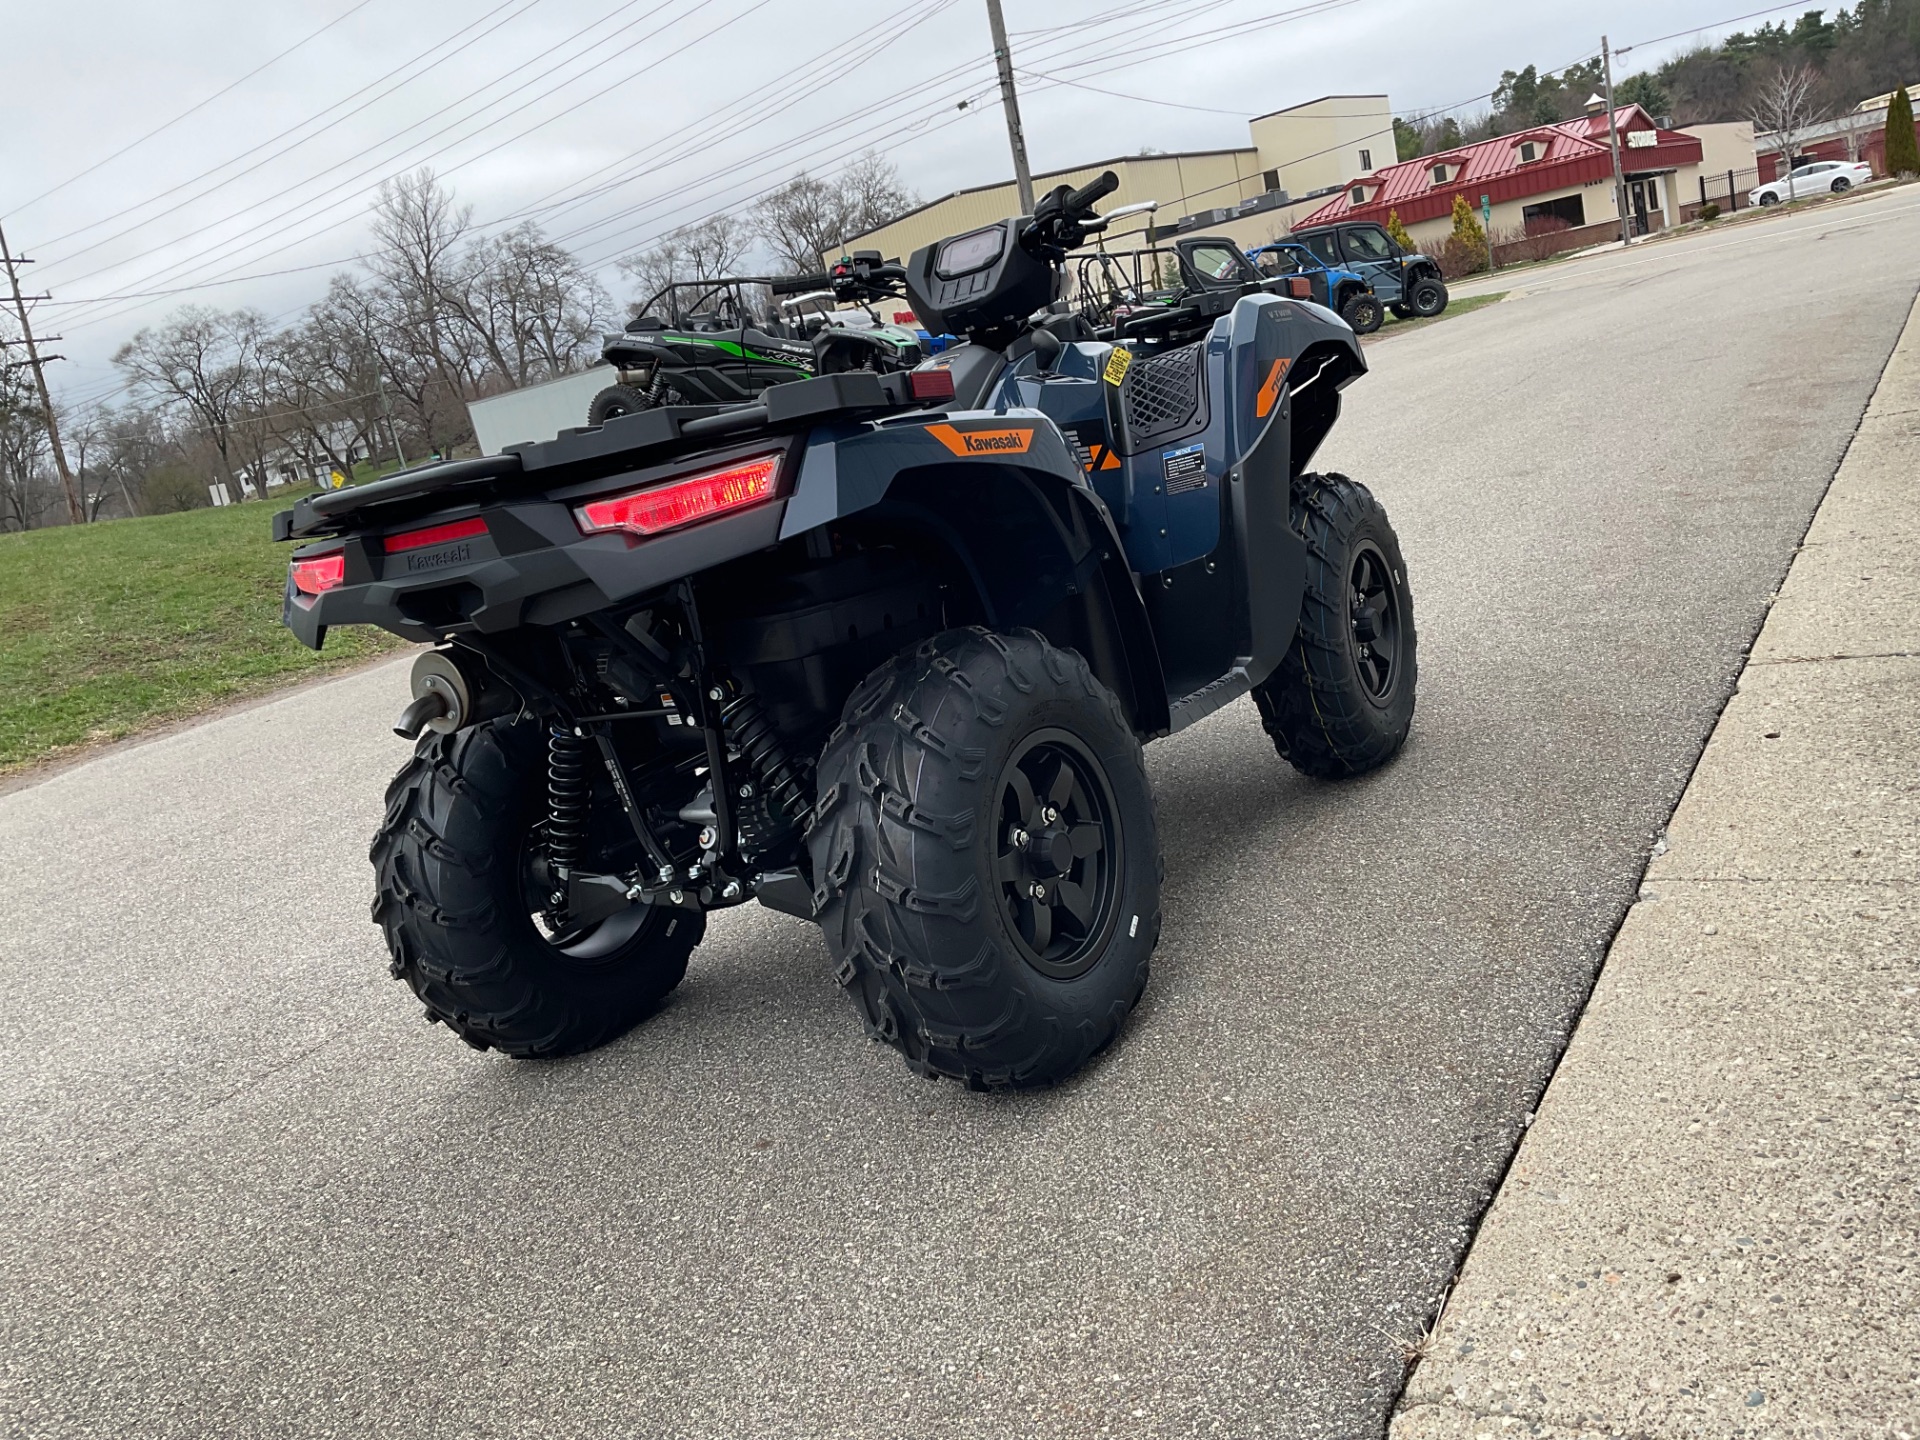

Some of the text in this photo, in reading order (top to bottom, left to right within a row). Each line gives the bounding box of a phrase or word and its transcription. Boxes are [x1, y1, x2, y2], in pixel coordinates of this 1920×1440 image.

[622, 333, 655, 343] Kawasaki
[963, 432, 1023, 452] Kawasaki
[407, 543, 470, 572] Kawasaki
